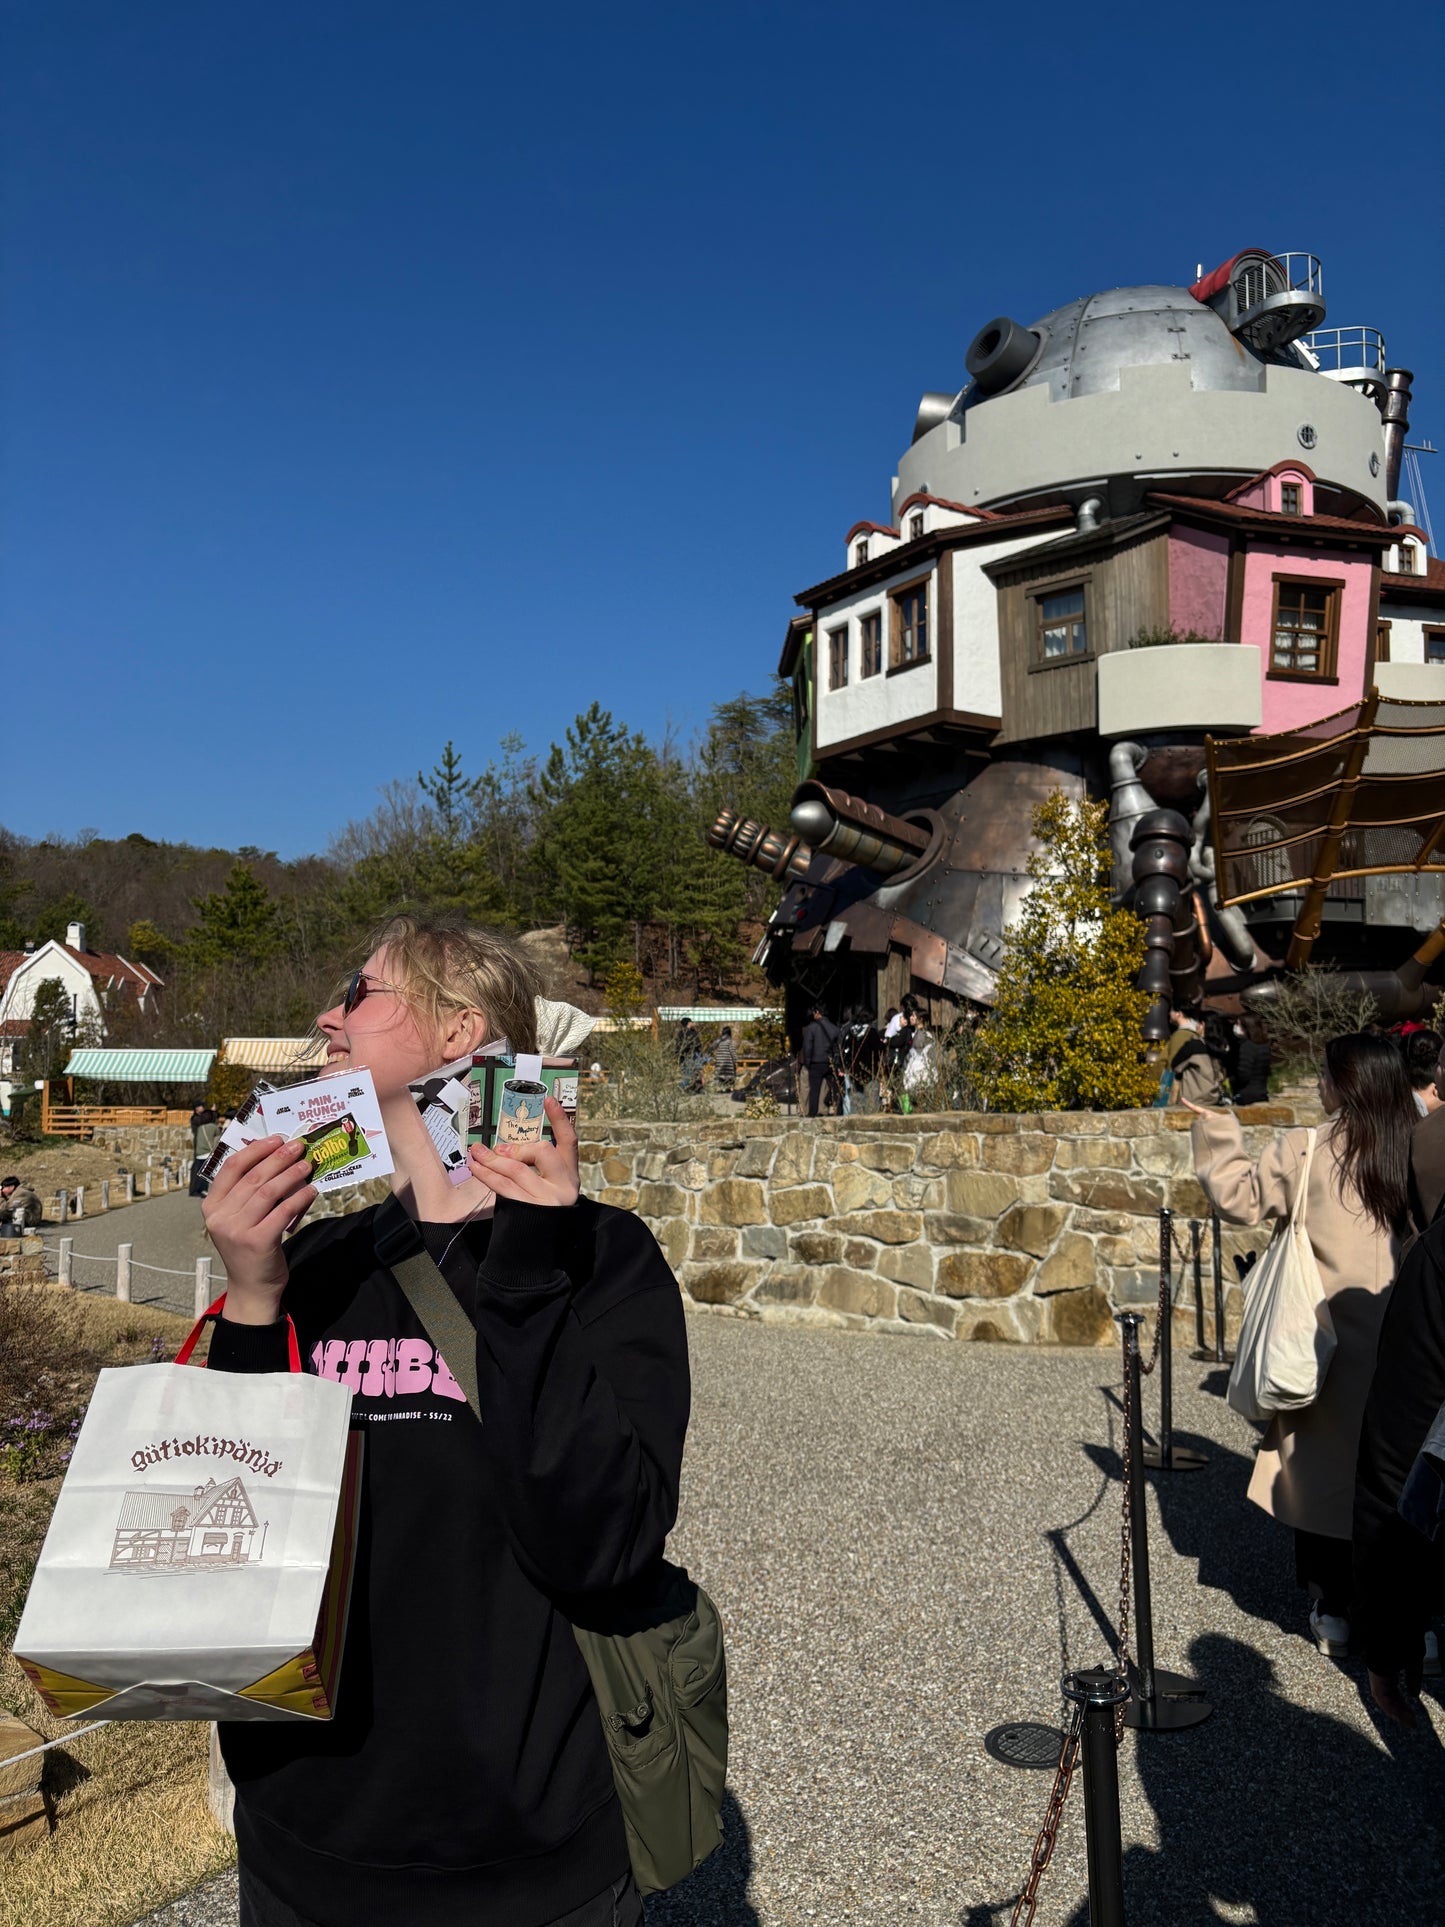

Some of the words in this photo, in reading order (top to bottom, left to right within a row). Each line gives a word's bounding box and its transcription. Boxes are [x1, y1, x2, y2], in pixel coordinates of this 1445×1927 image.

[308, 1094, 332, 1108] MIN
[297, 1101, 346, 1121] BRUNCH
[313, 1138, 347, 1164] galbo
[324, 1170, 354, 1182] COLLECTION
[429, 1411, 453, 1421] SS/22
